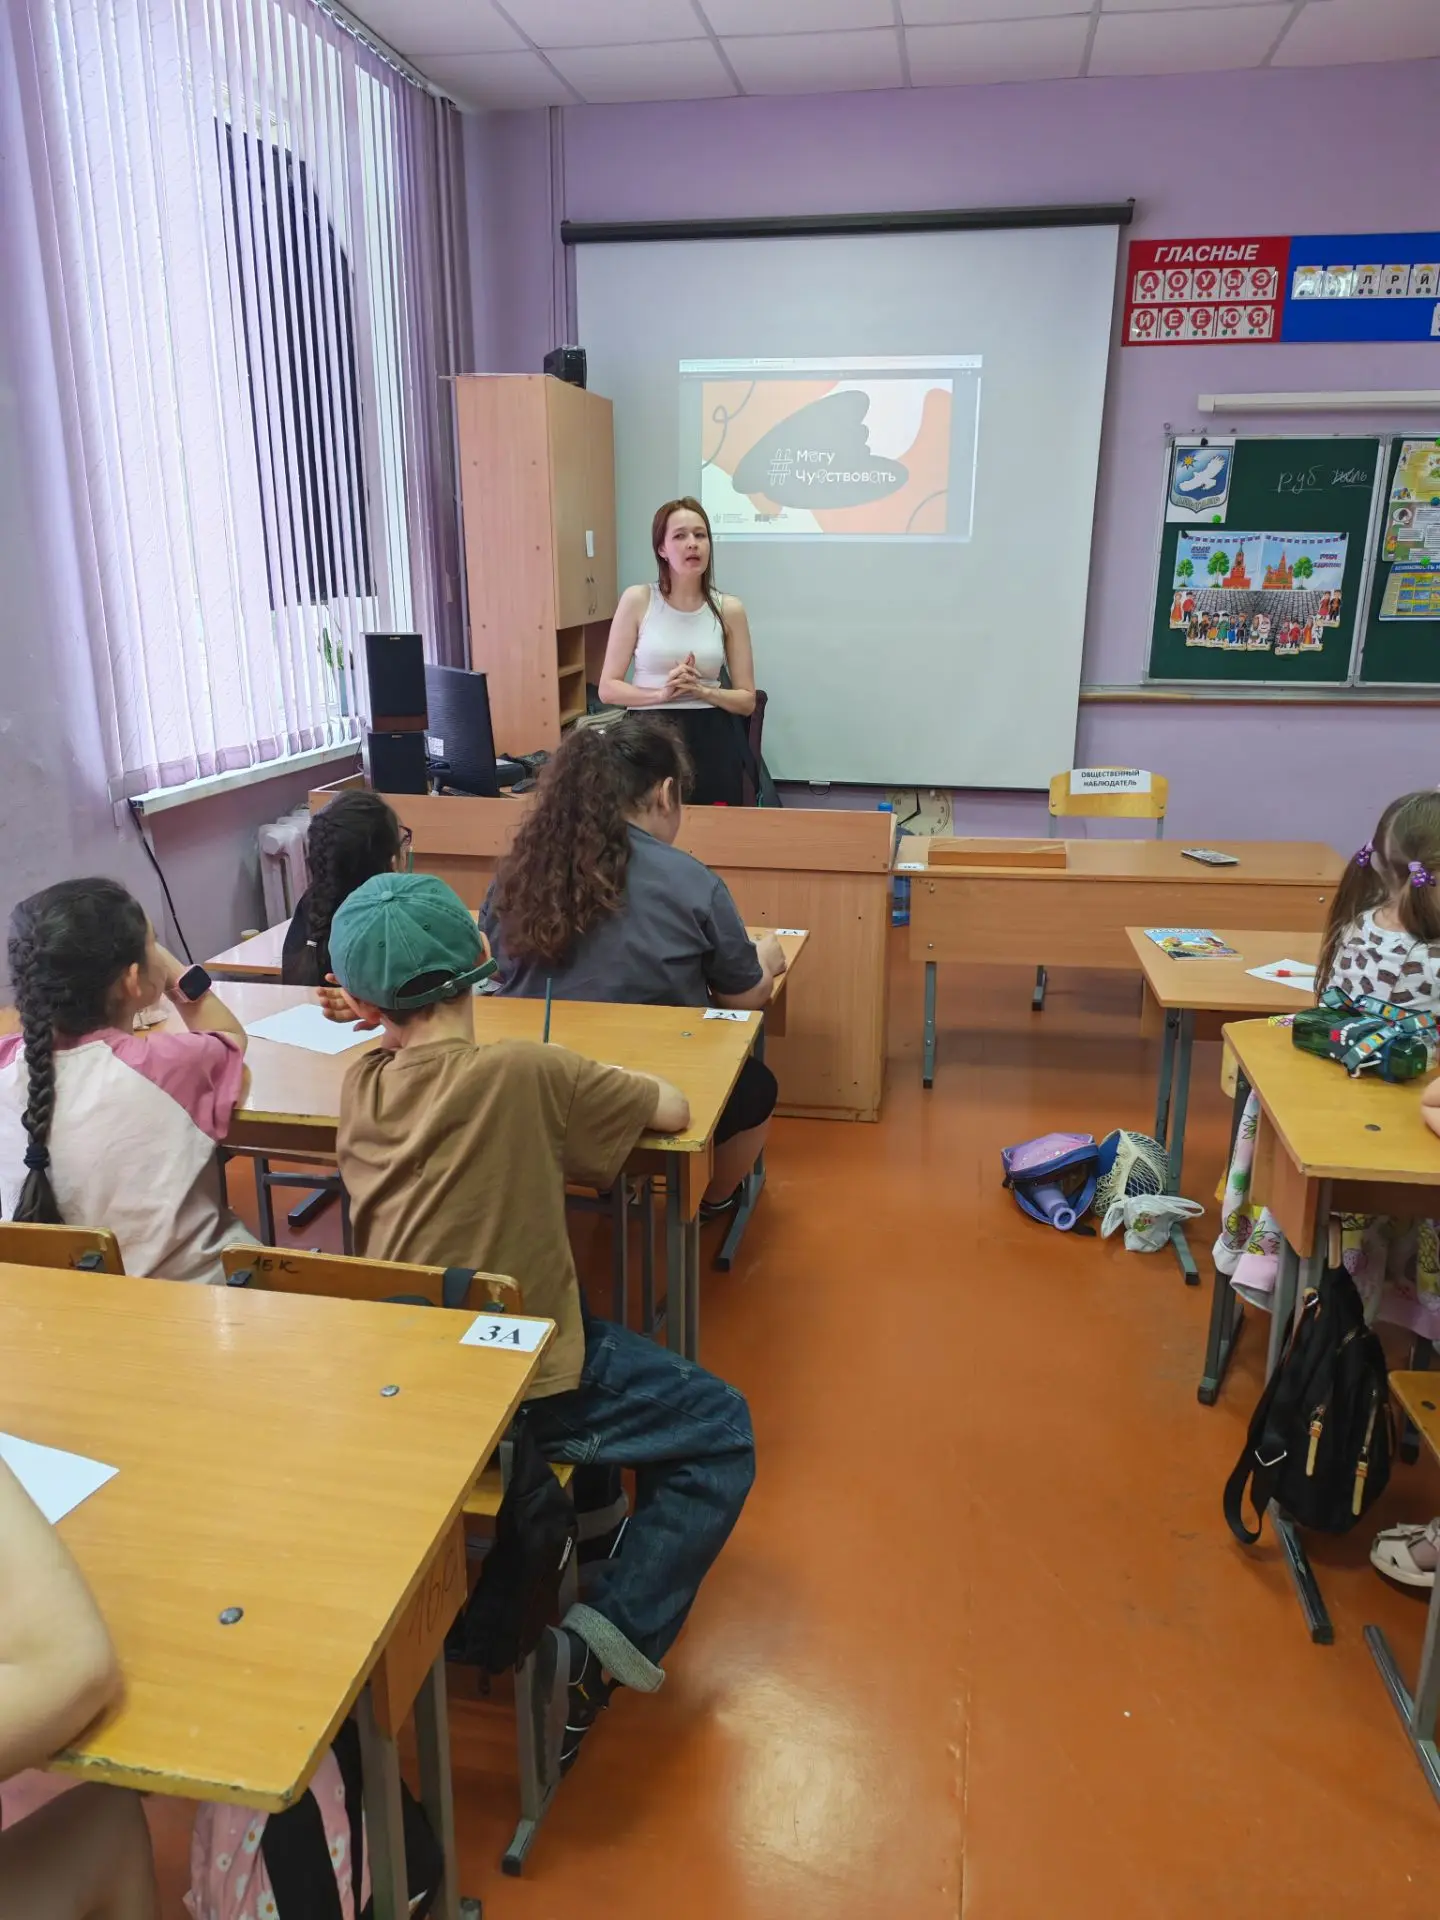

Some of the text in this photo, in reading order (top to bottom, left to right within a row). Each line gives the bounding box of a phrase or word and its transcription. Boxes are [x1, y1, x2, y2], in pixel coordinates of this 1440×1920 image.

[1154, 244, 1259, 263] ГЛАСНЫЕ
[1144, 272, 1268, 289] А О У Ы Э
[1362, 275, 1372, 284] Л
[1390, 275, 1399, 284] Р
[1168, 313, 1179, 325] Е
[1222, 312, 1239, 325] Ю
[1252, 311, 1264, 323] Я
[1081, 769, 1140, 779] ОБЩЕСТВЕННЫЙ
[1083, 779, 1137, 787] НАБЛЮДАТЕЛЬ
[478, 1325, 520, 1345] 3А
